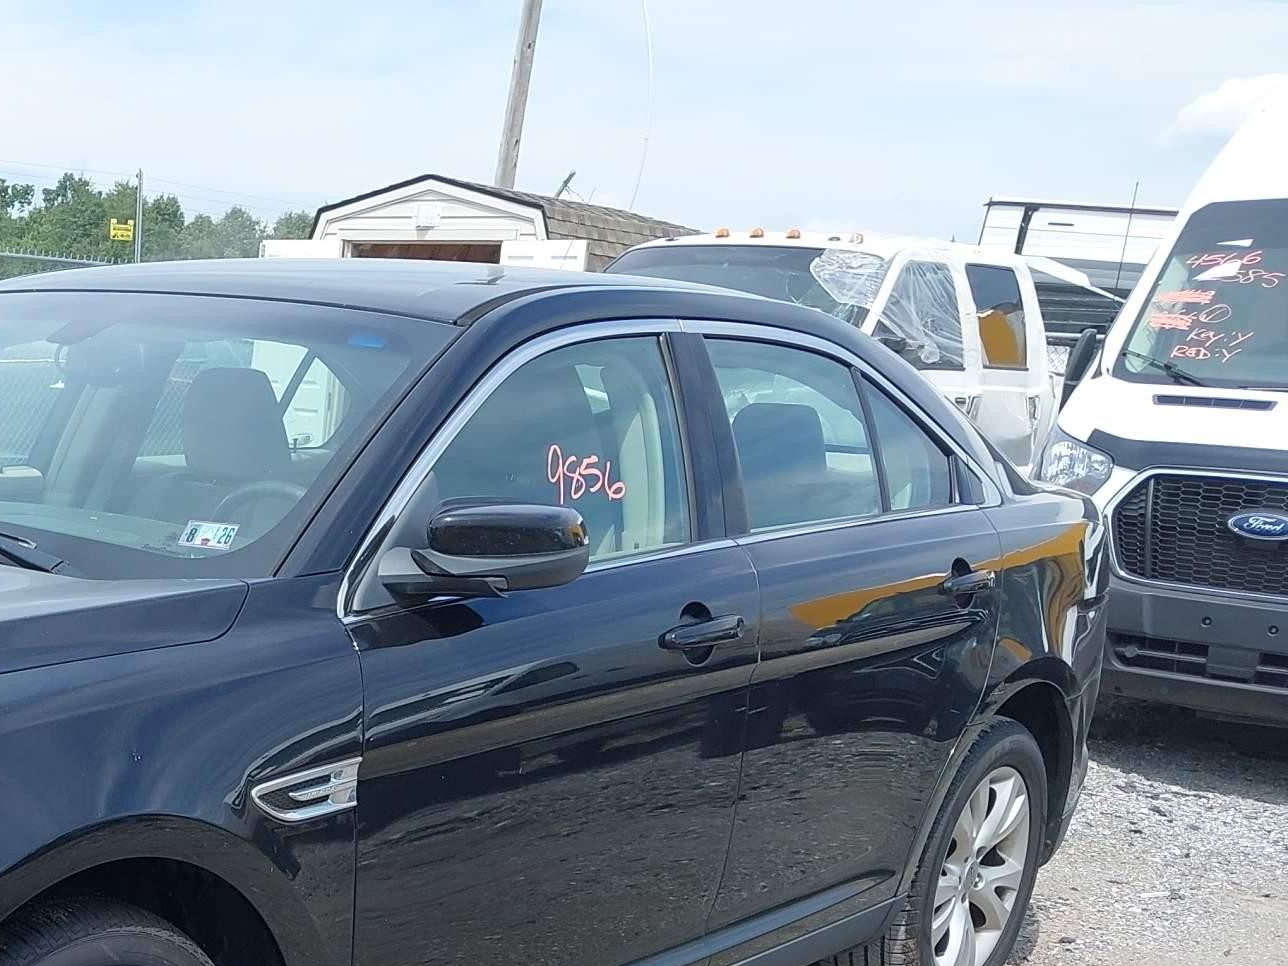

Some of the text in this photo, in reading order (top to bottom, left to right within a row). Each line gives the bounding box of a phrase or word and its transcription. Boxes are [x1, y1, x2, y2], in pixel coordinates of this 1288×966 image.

[548, 444, 626, 504] 9856
[1243, 516, 1286, 532] Ford
[186, 526, 235, 545] 8 26
